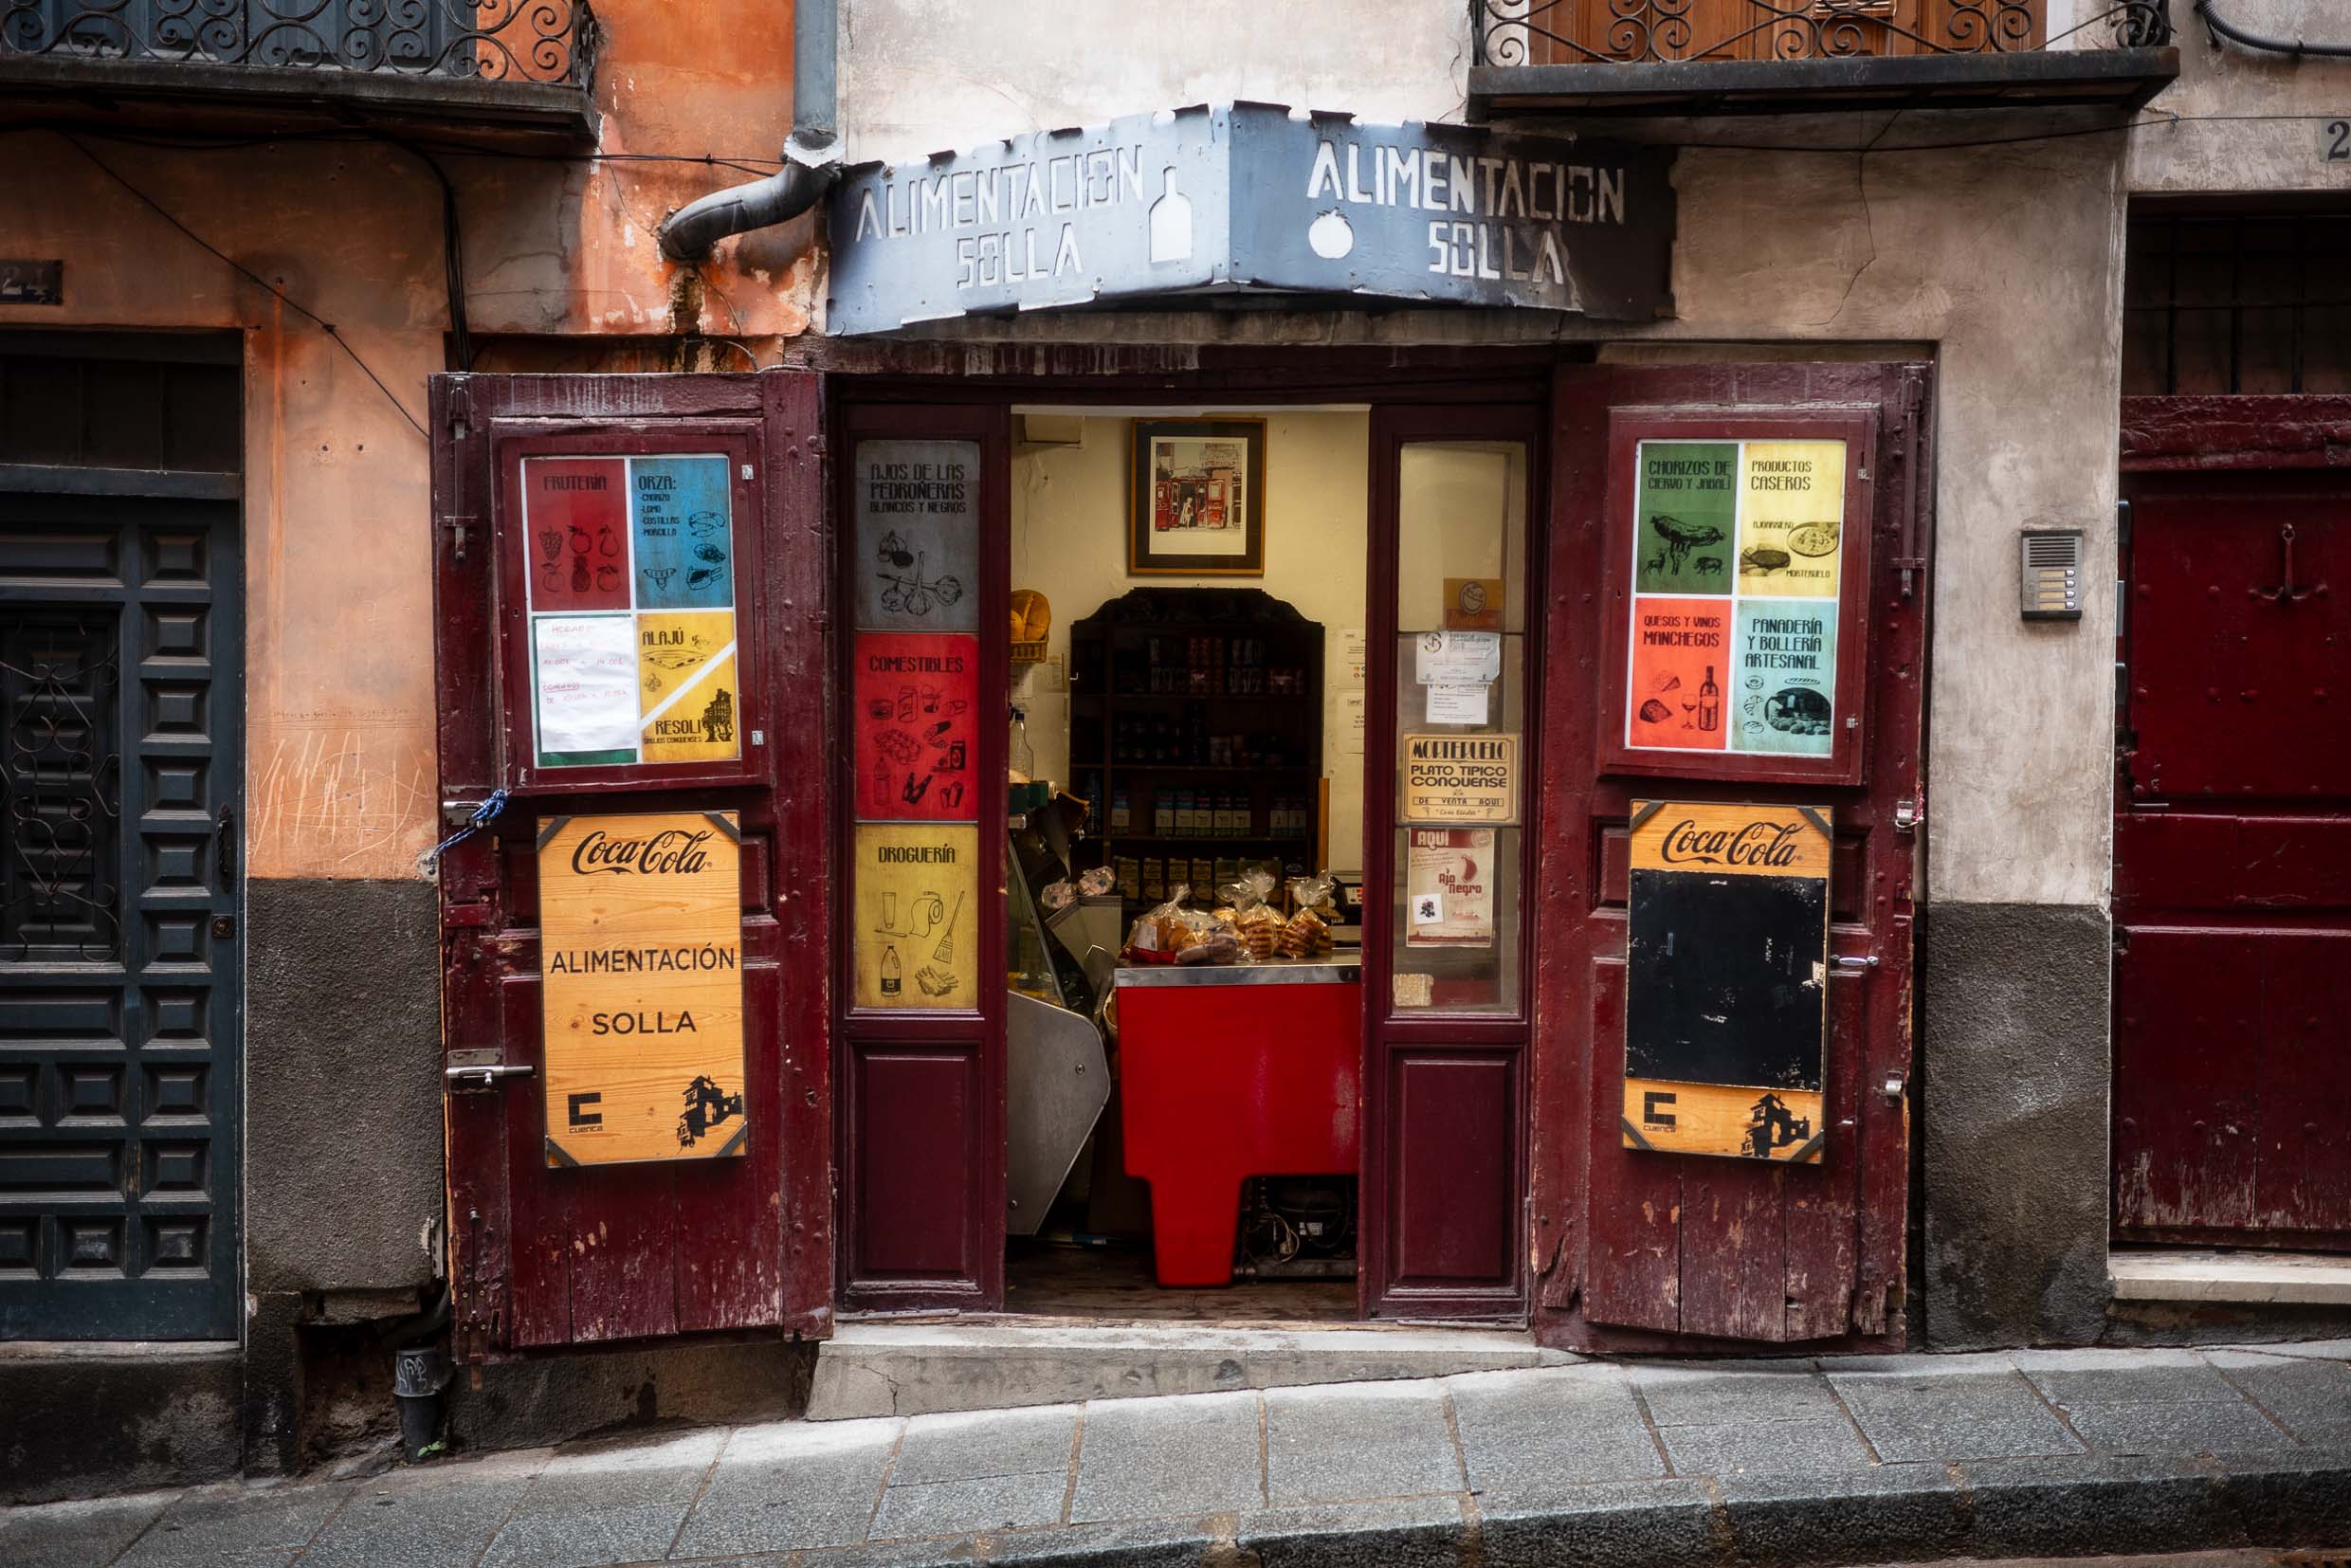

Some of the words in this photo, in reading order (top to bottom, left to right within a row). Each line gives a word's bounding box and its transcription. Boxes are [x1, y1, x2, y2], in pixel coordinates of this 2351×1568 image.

[1308, 139, 1625, 225] ALIMENTACION
[855, 144, 1144, 243] ALIMENTACION
[957, 222, 1084, 289] SOLLA
[1429, 219, 1564, 285] SOLLA
[870, 463, 908, 481] AJOS
[913, 463, 933, 481] DE
[937, 463, 965, 481] LAS
[1649, 460, 1710, 475] CHORIZOS
[1714, 461, 1732, 477] DE
[1751, 460, 1813, 473] PRODUCTOS
[1686, 478, 1693, 490] Y
[1751, 475, 1812, 491] CASEROS
[918, 501, 925, 513] Y
[1644, 615, 1681, 629] QUESOS
[1685, 616, 1691, 629] Y
[1693, 616, 1721, 629] VINOS
[1752, 617, 1823, 635] PANADERÍA
[642, 627, 684, 647] ALAJÚ
[1643, 630, 1720, 647] MANCHEGOS
[1747, 635, 1756, 650] Y
[1759, 634, 1822, 653] BOLLERÍA
[869, 655, 964, 674] COMESTIBLES
[1744, 653, 1820, 670] ARTESANAL
[1411, 764, 1454, 776] PLATO
[1459, 765, 1507, 777] TIPICO
[1411, 776, 1507, 788] CONQUENSE
[1661, 819, 1806, 867] Coca-Cola
[572, 830, 715, 875] Coca-Cola
[878, 843, 957, 864] DROGUERÍA
[550, 941, 735, 975] ALIMENTACIÓN
[592, 1011, 698, 1035] SOLLA
